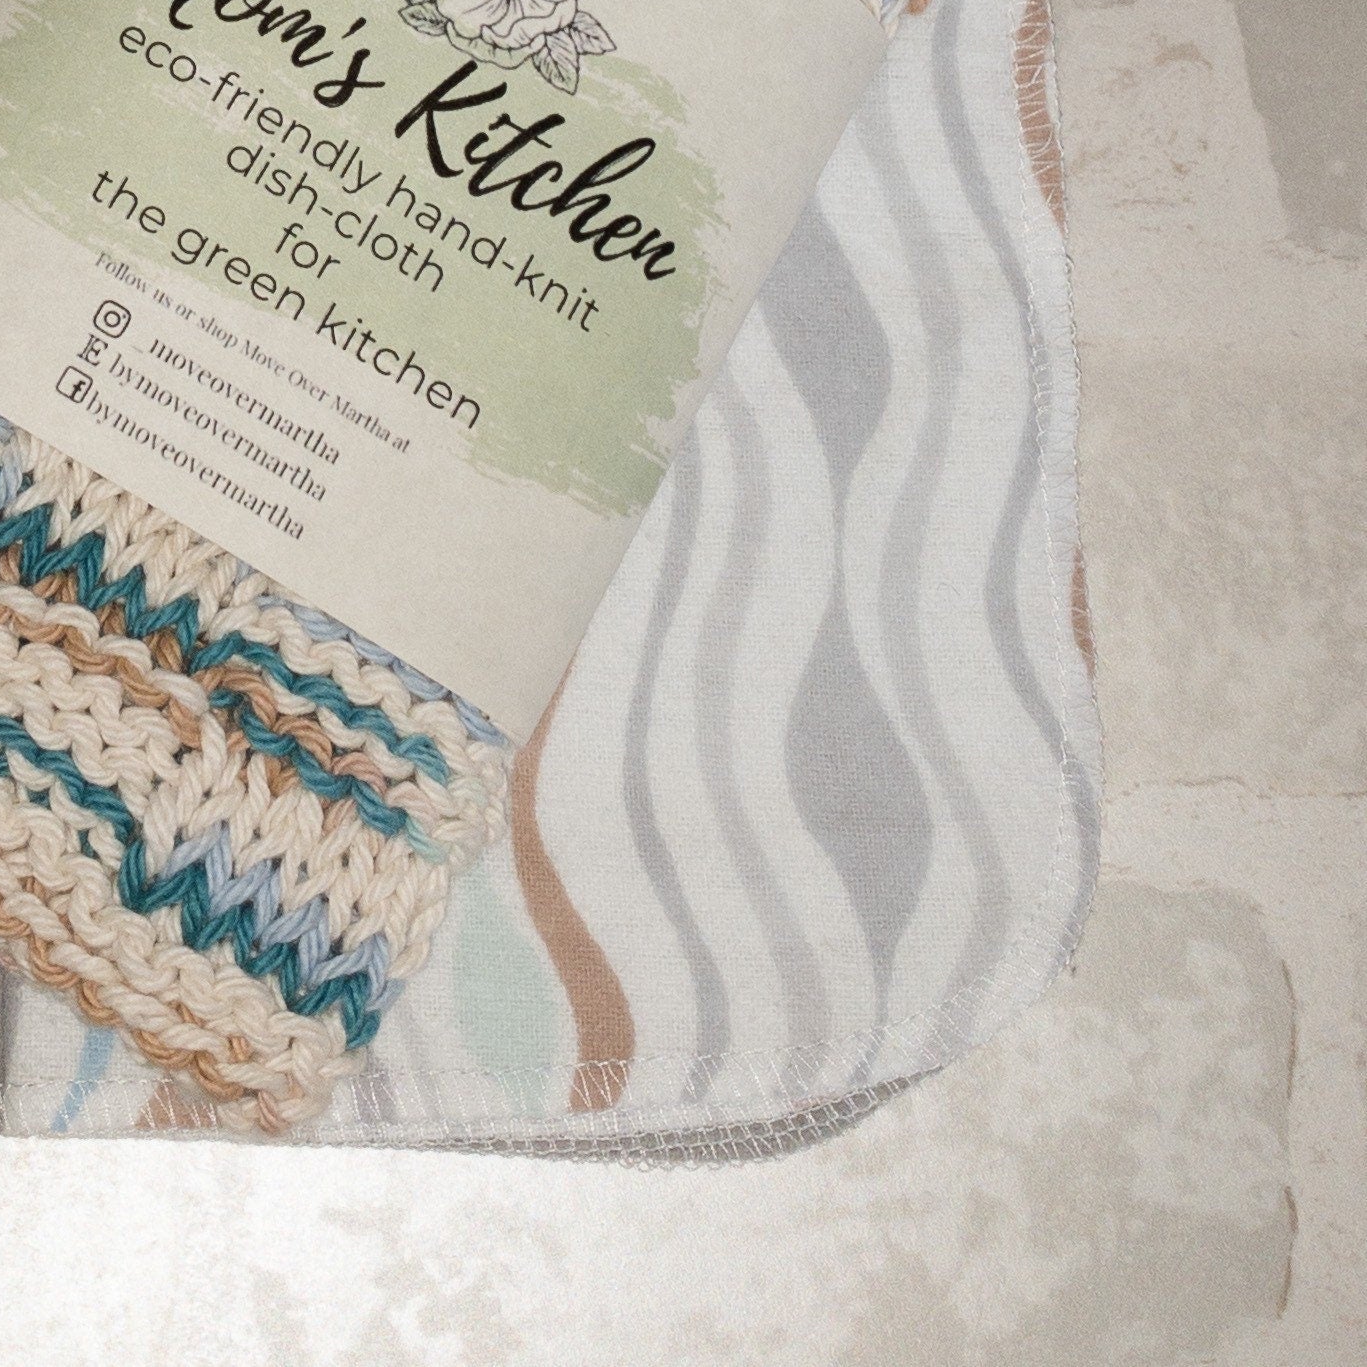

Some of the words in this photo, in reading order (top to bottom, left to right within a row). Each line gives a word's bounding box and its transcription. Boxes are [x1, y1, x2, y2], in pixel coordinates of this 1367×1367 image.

[117, 24, 384, 196] eco-friendly
[384, 173, 601, 334] hand-knit
[225, 144, 445, 294] dish-cloth
[273, 221, 342, 280] for
[393, 58, 677, 282] Kitchen
[91, 169, 167, 235] the
[169, 226, 307, 322] green
[314, 301, 482, 430] kitchen
[95, 250, 148, 294] Follow
[151, 287, 173, 310] us
[174, 303, 197, 322] or
[198, 315, 240, 350] shop
[241, 338, 287, 376] Move
[286, 369, 331, 403] Over
[331, 395, 392, 441] Martha
[390, 436, 412, 455] at
[85, 389, 305, 541] bymoveovermartha
[107, 351, 328, 503] bymoveovermartha
